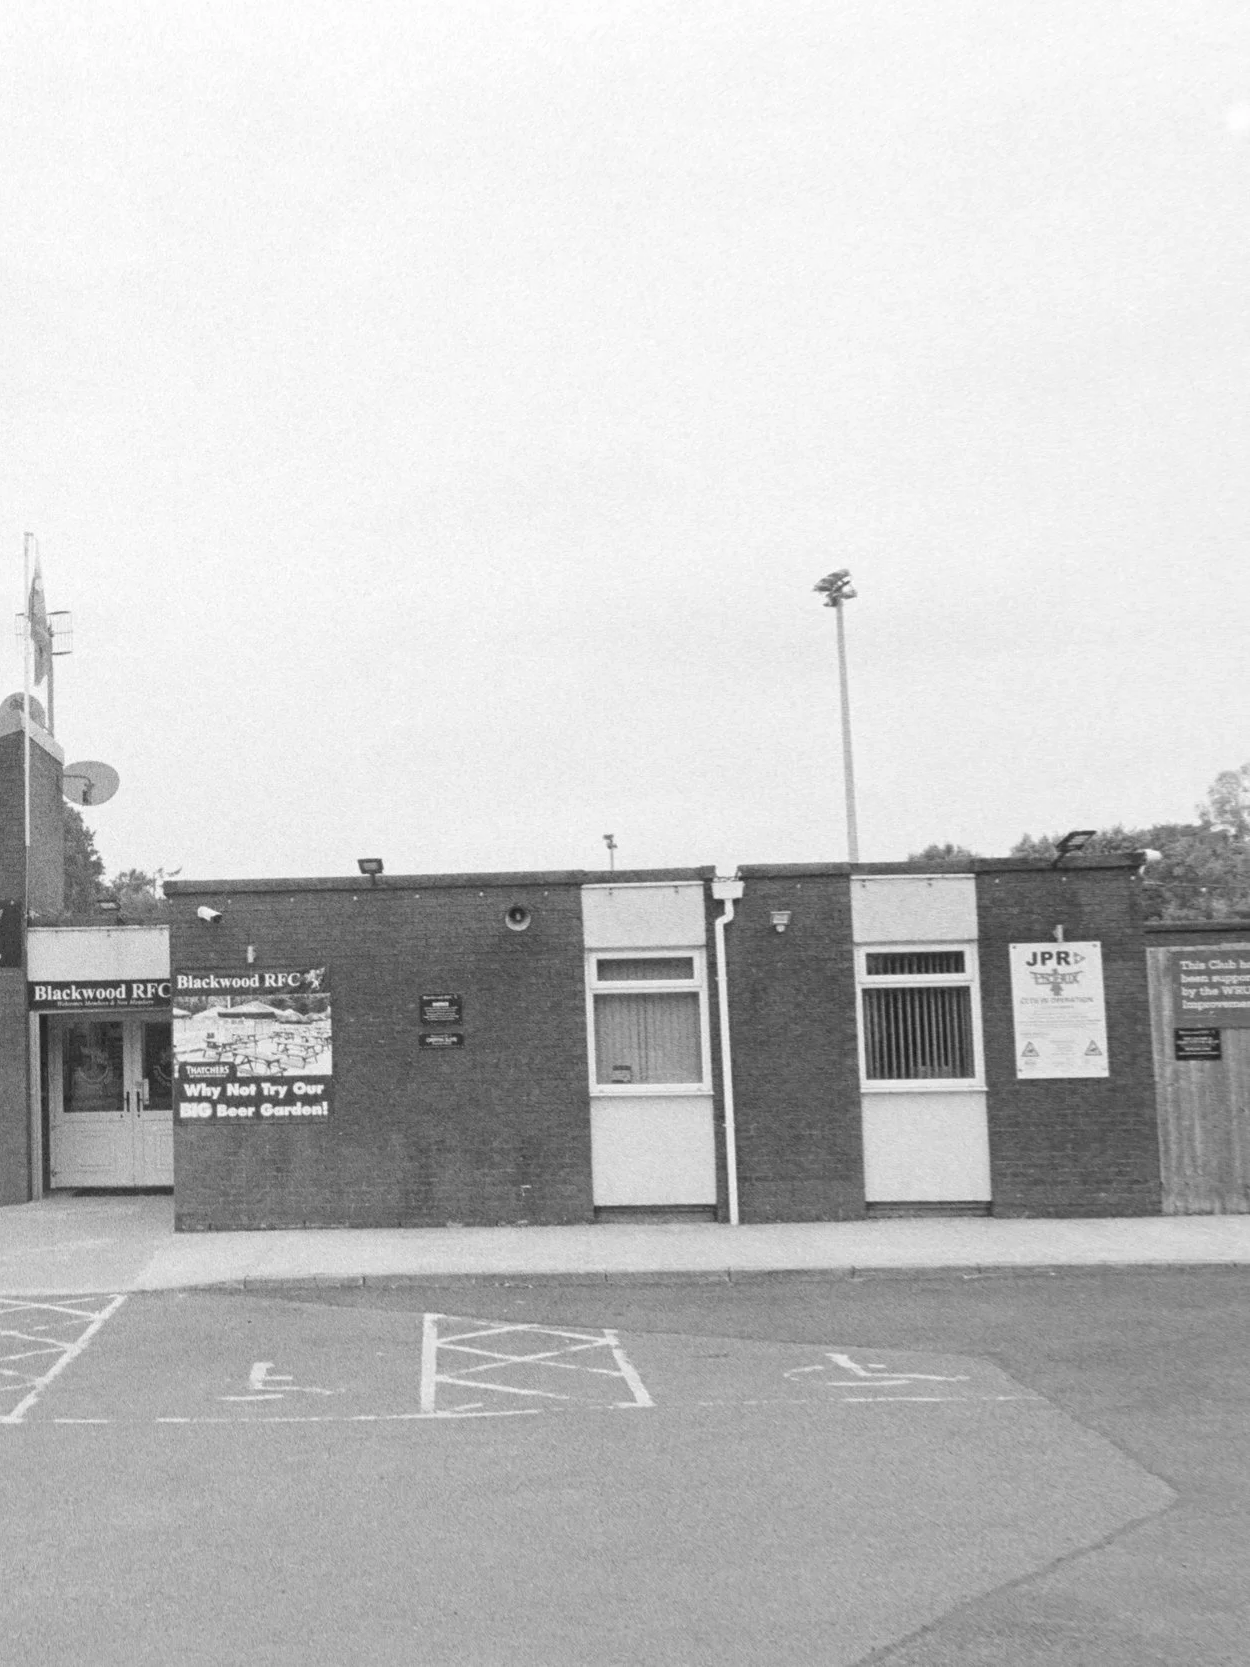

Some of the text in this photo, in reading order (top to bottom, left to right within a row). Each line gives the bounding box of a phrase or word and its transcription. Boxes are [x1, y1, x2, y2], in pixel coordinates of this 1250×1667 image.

[1025, 950, 1071, 967] JPR
[1179, 960, 1206, 970] This
[1208, 959, 1237, 969] Club
[176, 972, 301, 989] Blackwood RFC
[1180, 973, 1209, 983] been
[34, 982, 171, 1001] Blackwood RFC
[1180, 986, 1197, 998] by
[1199, 985, 1219, 996] the
[186, 1065, 230, 1075] THATCHERS
[184, 1081, 325, 1100] Why Not Try Our
[180, 1101, 328, 1118] BIG Beer Garden!
